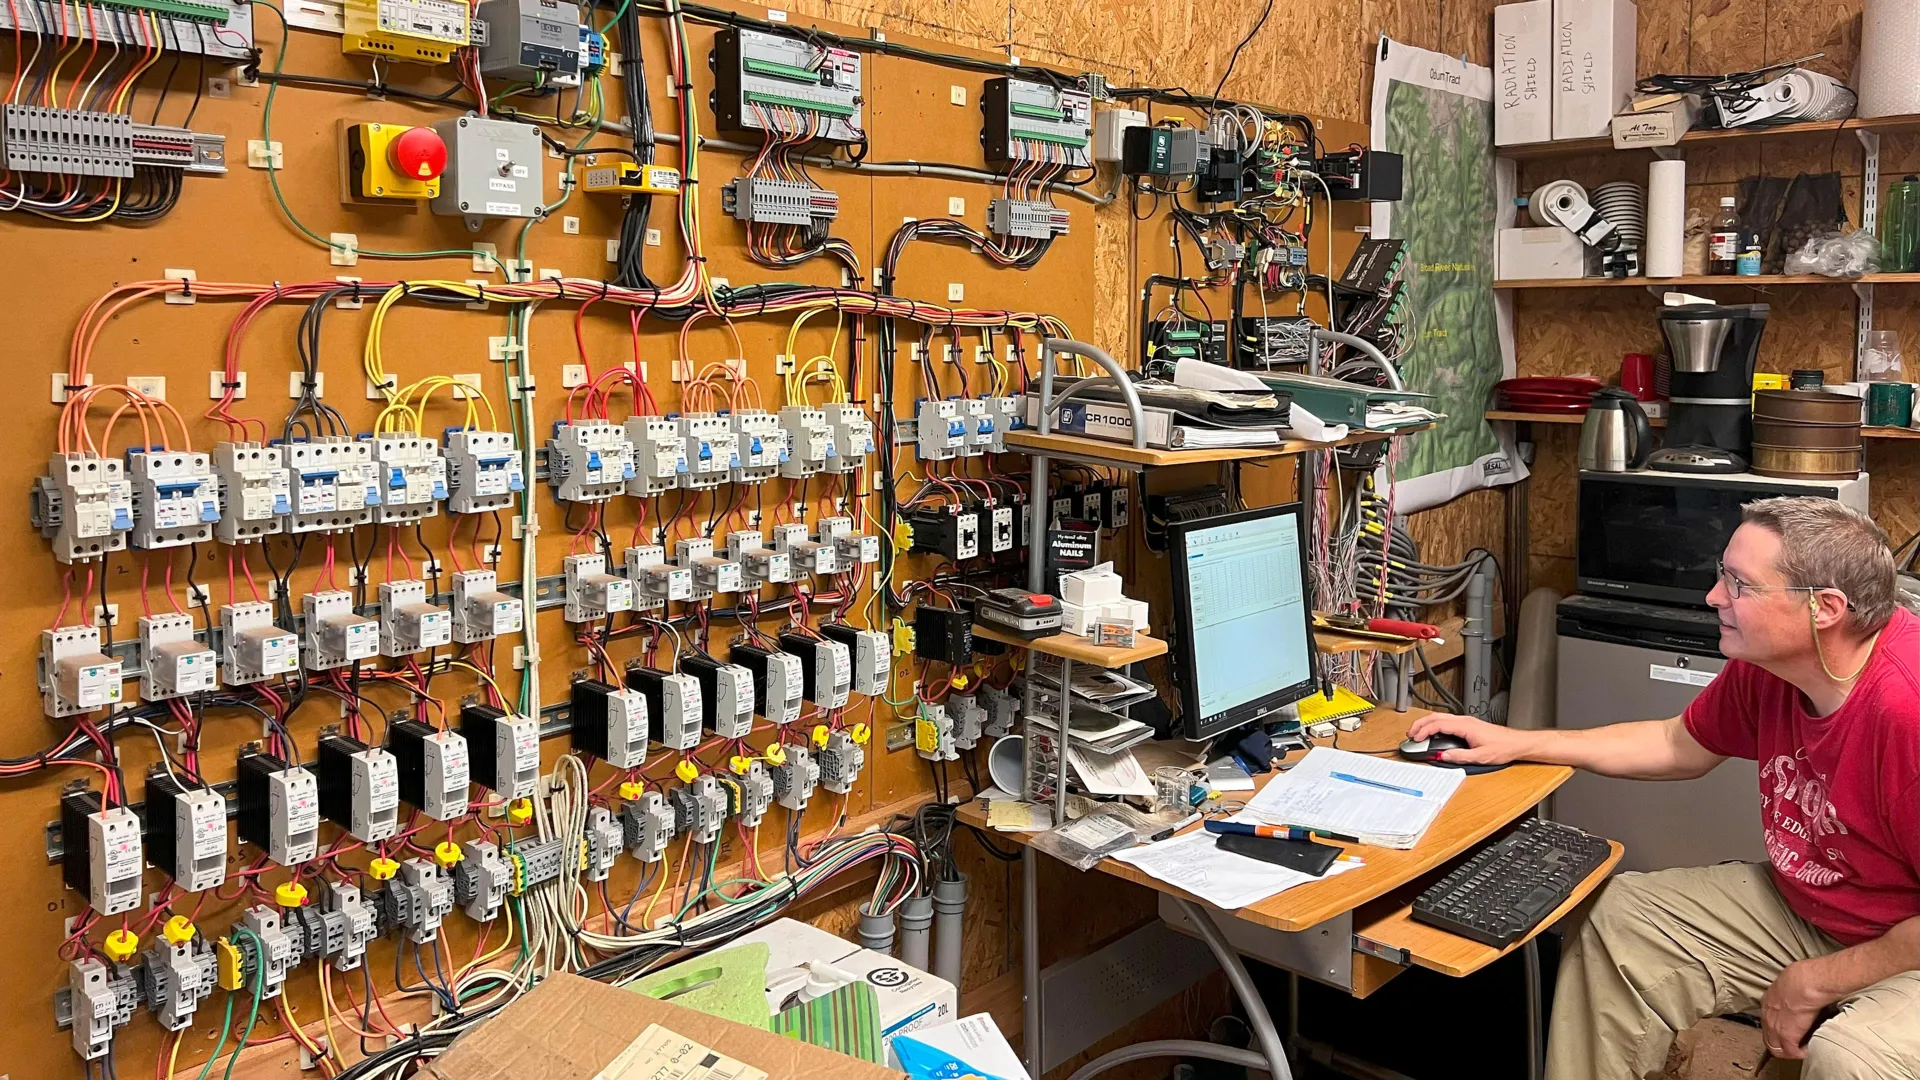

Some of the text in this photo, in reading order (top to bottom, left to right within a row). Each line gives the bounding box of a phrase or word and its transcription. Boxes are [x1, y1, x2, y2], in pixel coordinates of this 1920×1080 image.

[541, 24, 562, 33] SOLA
[1560, 21, 1576, 92] RADIATION
[1499, 33, 1520, 110] RADIATION
[1581, 52, 1596, 95] SHIELD
[1444, 71, 1461, 85] Tract
[1524, 57, 1538, 101] SHIELD
[1629, 123, 1657, 132] Al Tag
[491, 182, 515, 190] BYPASS
[1435, 263, 1451, 272] River
[1086, 413, 1133, 428] CR1000
[1052, 540, 1092, 550] Aluminum
[1060, 549, 1084, 557] NAILS
[117, 565, 128, 574] 2
[491, 886, 497, 897] 9
[351, 934, 358, 942] 5
[271, 961, 277, 970] 6
[181, 993, 189, 1002] 2
[938, 1003, 949, 1017] 20L
[899, 1017, 925, 1037] PROOF
[670, 1043, 693, 1064] 0-02
